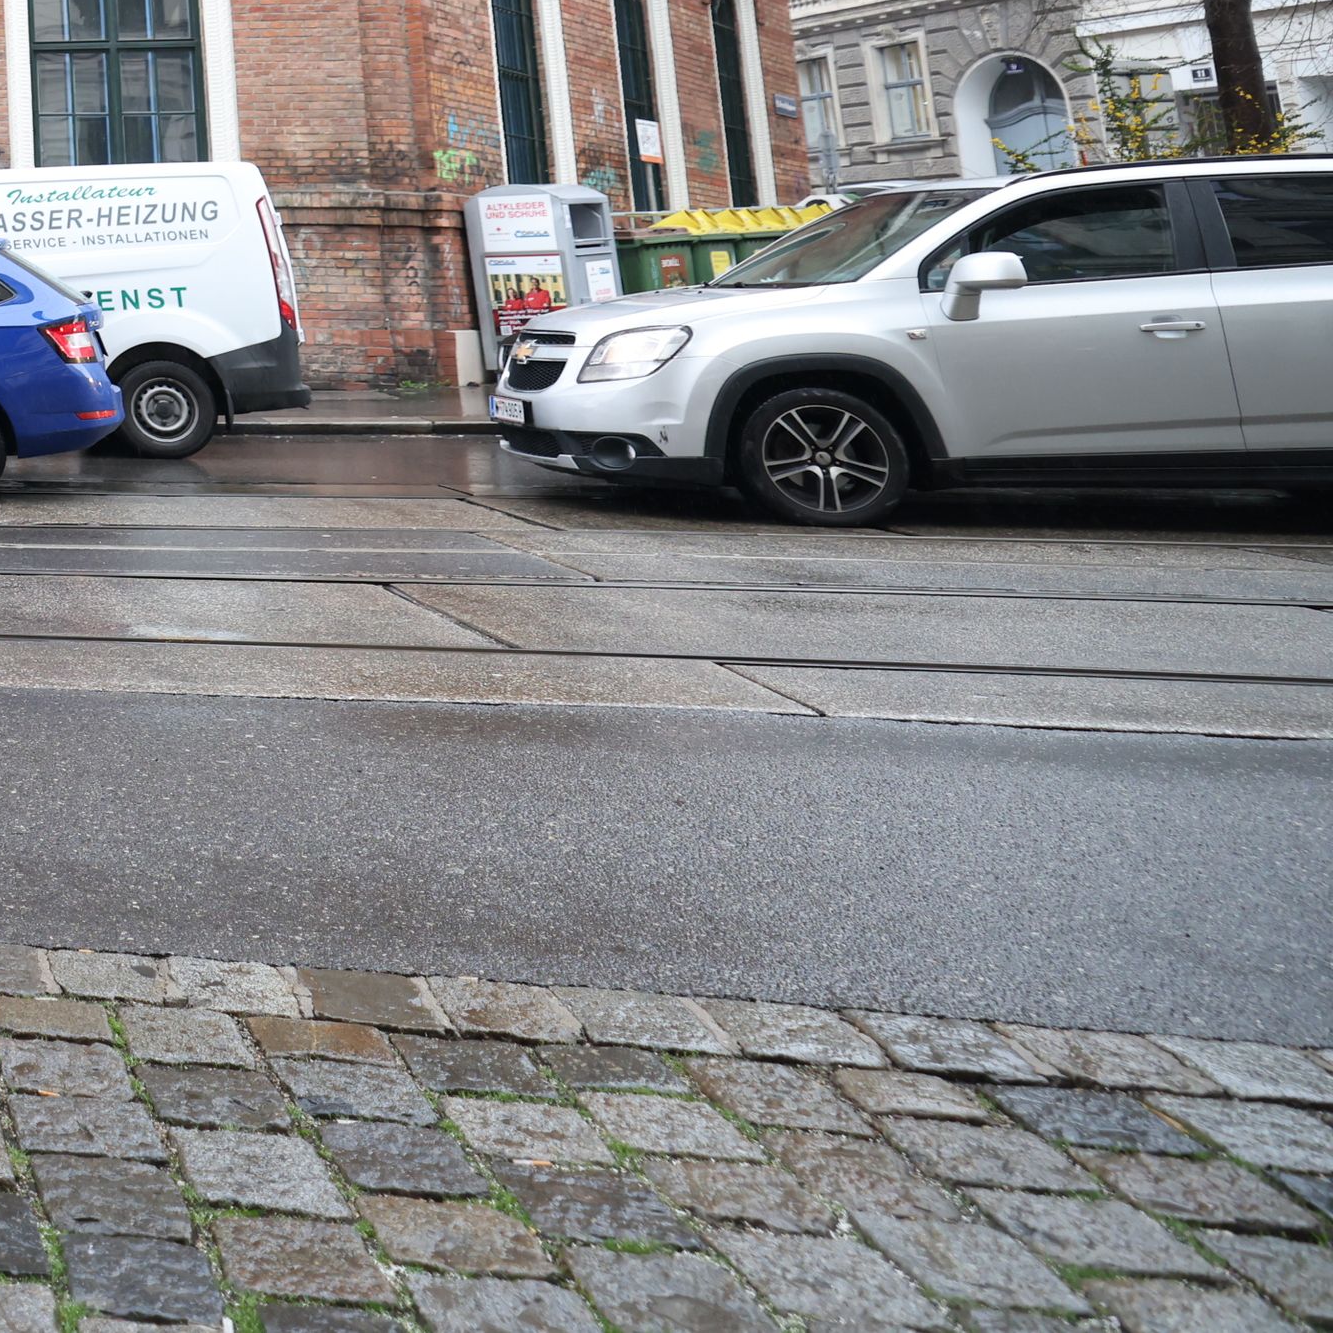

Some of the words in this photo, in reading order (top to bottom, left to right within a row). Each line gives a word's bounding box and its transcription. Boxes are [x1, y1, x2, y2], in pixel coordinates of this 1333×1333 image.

[6, 185, 158, 205] Installateur
[486, 201, 546, 211] ALTKLEIDER
[485, 211, 506, 220] UND
[507, 209, 548, 219] SCHUHE
[81, 228, 209, 247] INSTALLATIONEN
